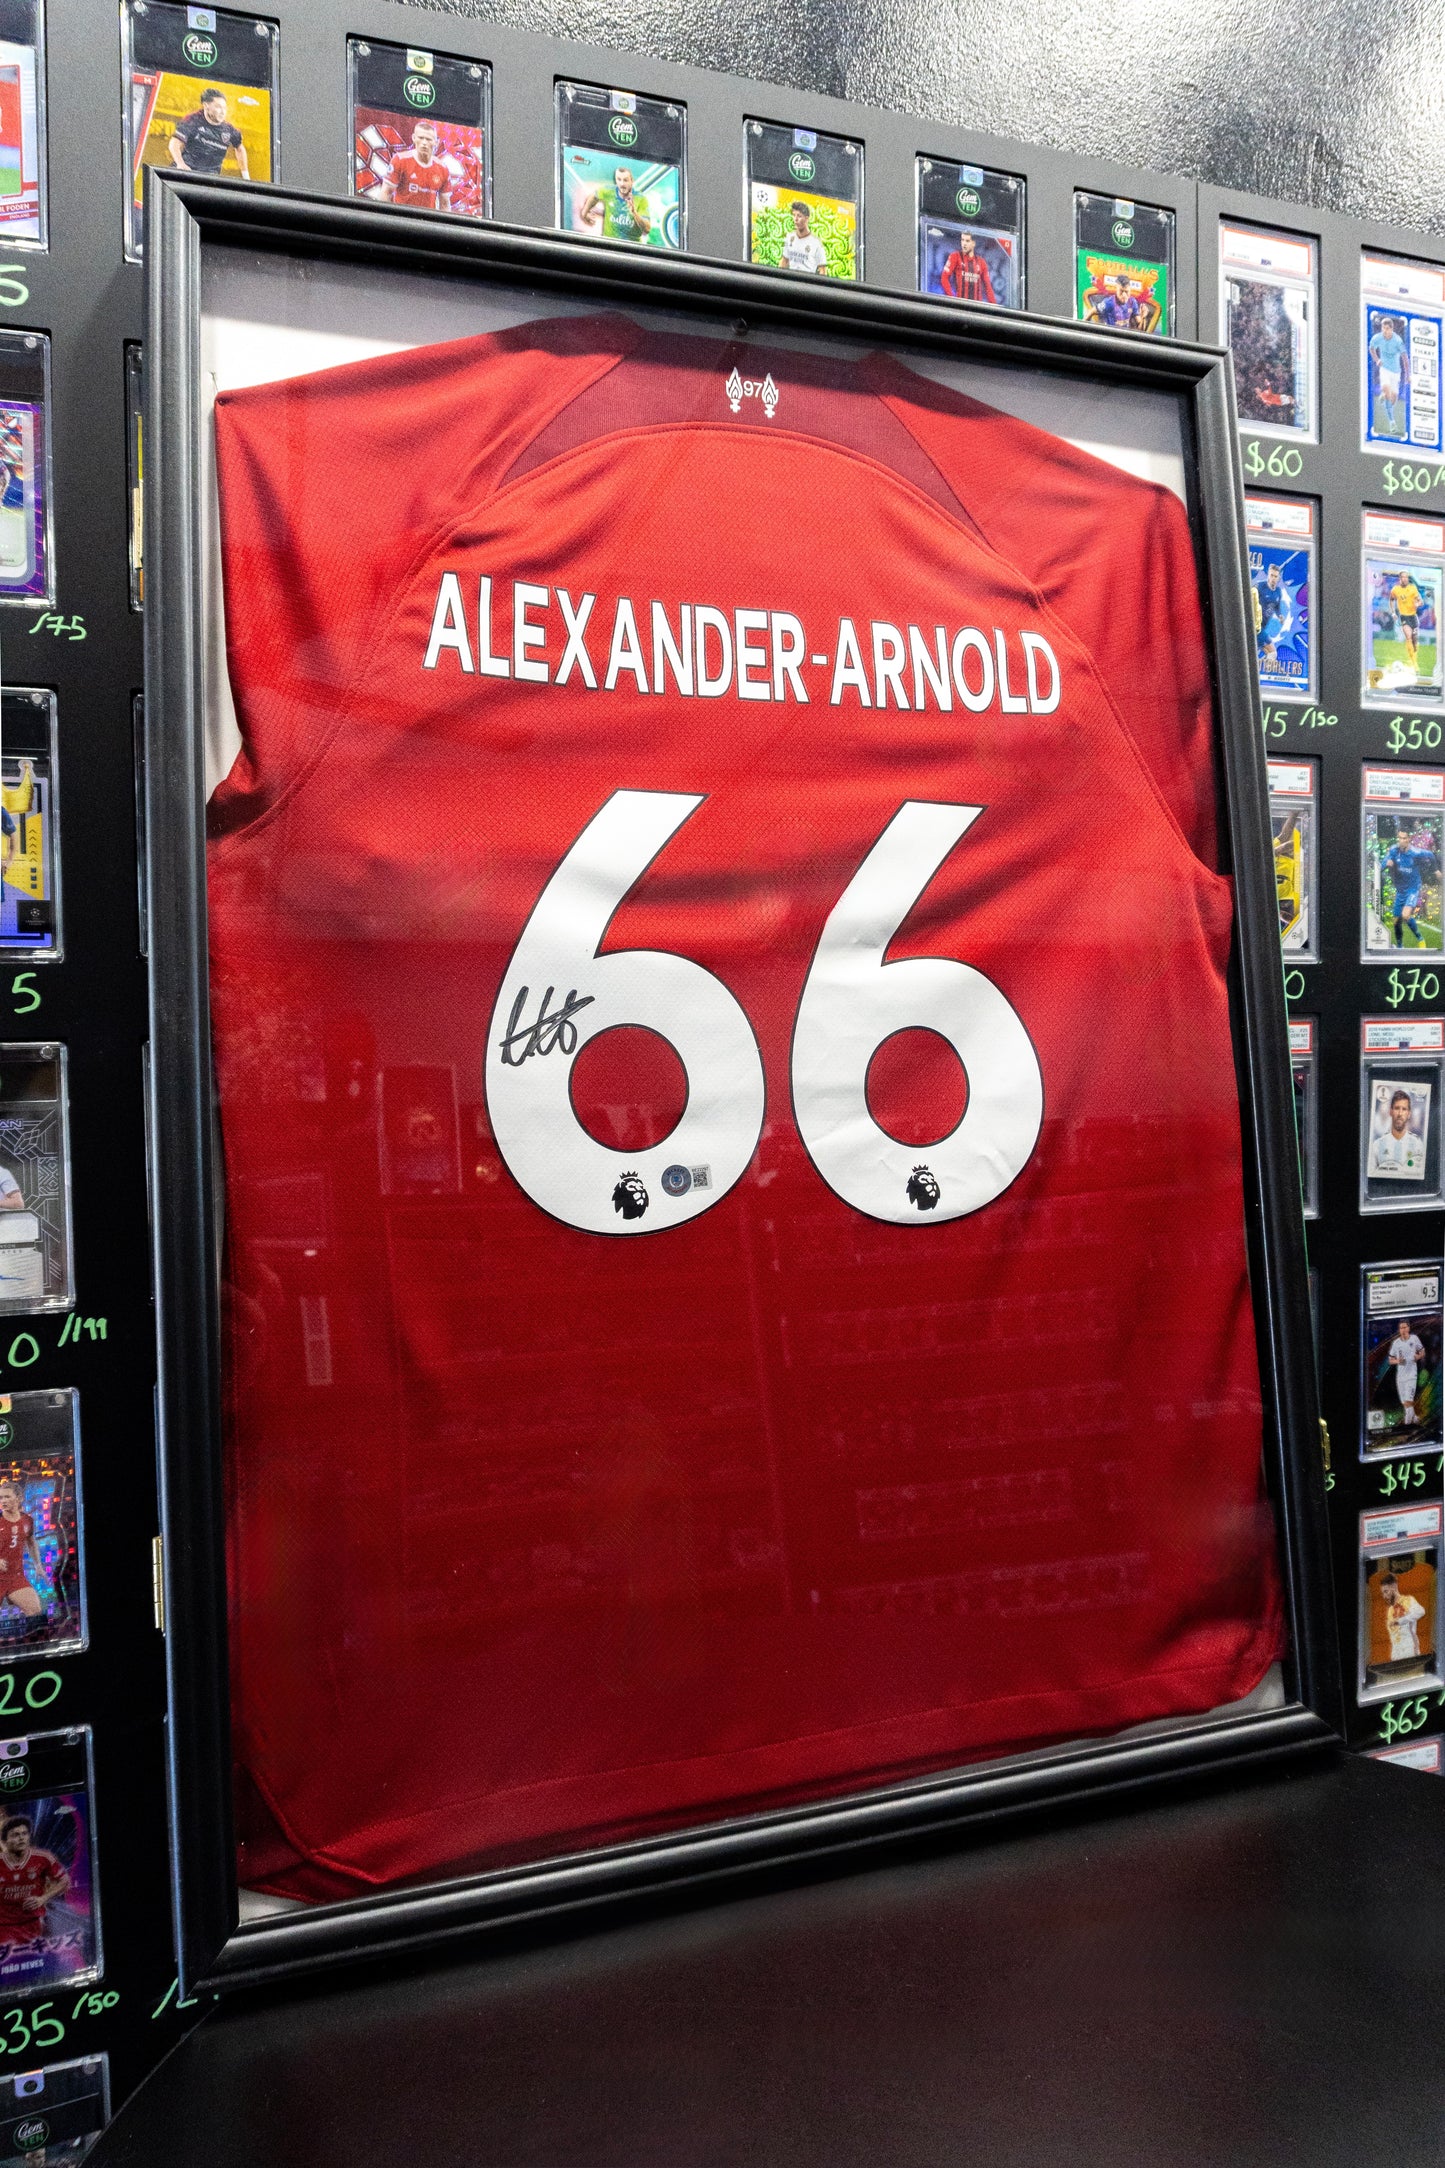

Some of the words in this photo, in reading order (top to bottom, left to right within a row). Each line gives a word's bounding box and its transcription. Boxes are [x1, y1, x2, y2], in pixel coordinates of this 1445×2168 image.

[186, 34, 213, 50] Gem
[191, 52, 212, 62] TEN
[407, 78, 431, 92] Gem
[410, 92, 430, 103] TEN
[612, 119, 633, 132] Gem
[615, 133, 633, 142] TEN
[792, 155, 811, 167] Gem
[959, 190, 977, 201] Gem
[6, 203, 31, 212] FODEN
[961, 202, 977, 212] TEN
[1114, 224, 1131, 235] Gem
[1117, 235, 1131, 244] TEN
[743, 380, 763, 398] 97
[1244, 440, 1303, 477] $60
[1382, 460, 1431, 496] $80
[422, 571, 1062, 715] ALEXANDER-ARNOLD
[1299, 707, 1339, 729] /150
[1386, 715, 1442, 754] $50
[12, 972, 42, 1014] 5
[1385, 968, 1440, 1008] $70
[483, 787, 1046, 1239] 66
[1422, 1286, 1437, 1298] 9.5
[57, 1313, 108, 1347] /199
[1379, 1462, 1427, 1496] $45
[0, 1670, 62, 1715] 20
[1379, 1696, 1429, 1744] $65
[20, 1958, 44, 1970] NEVES
[72, 1991, 120, 2020] /50
